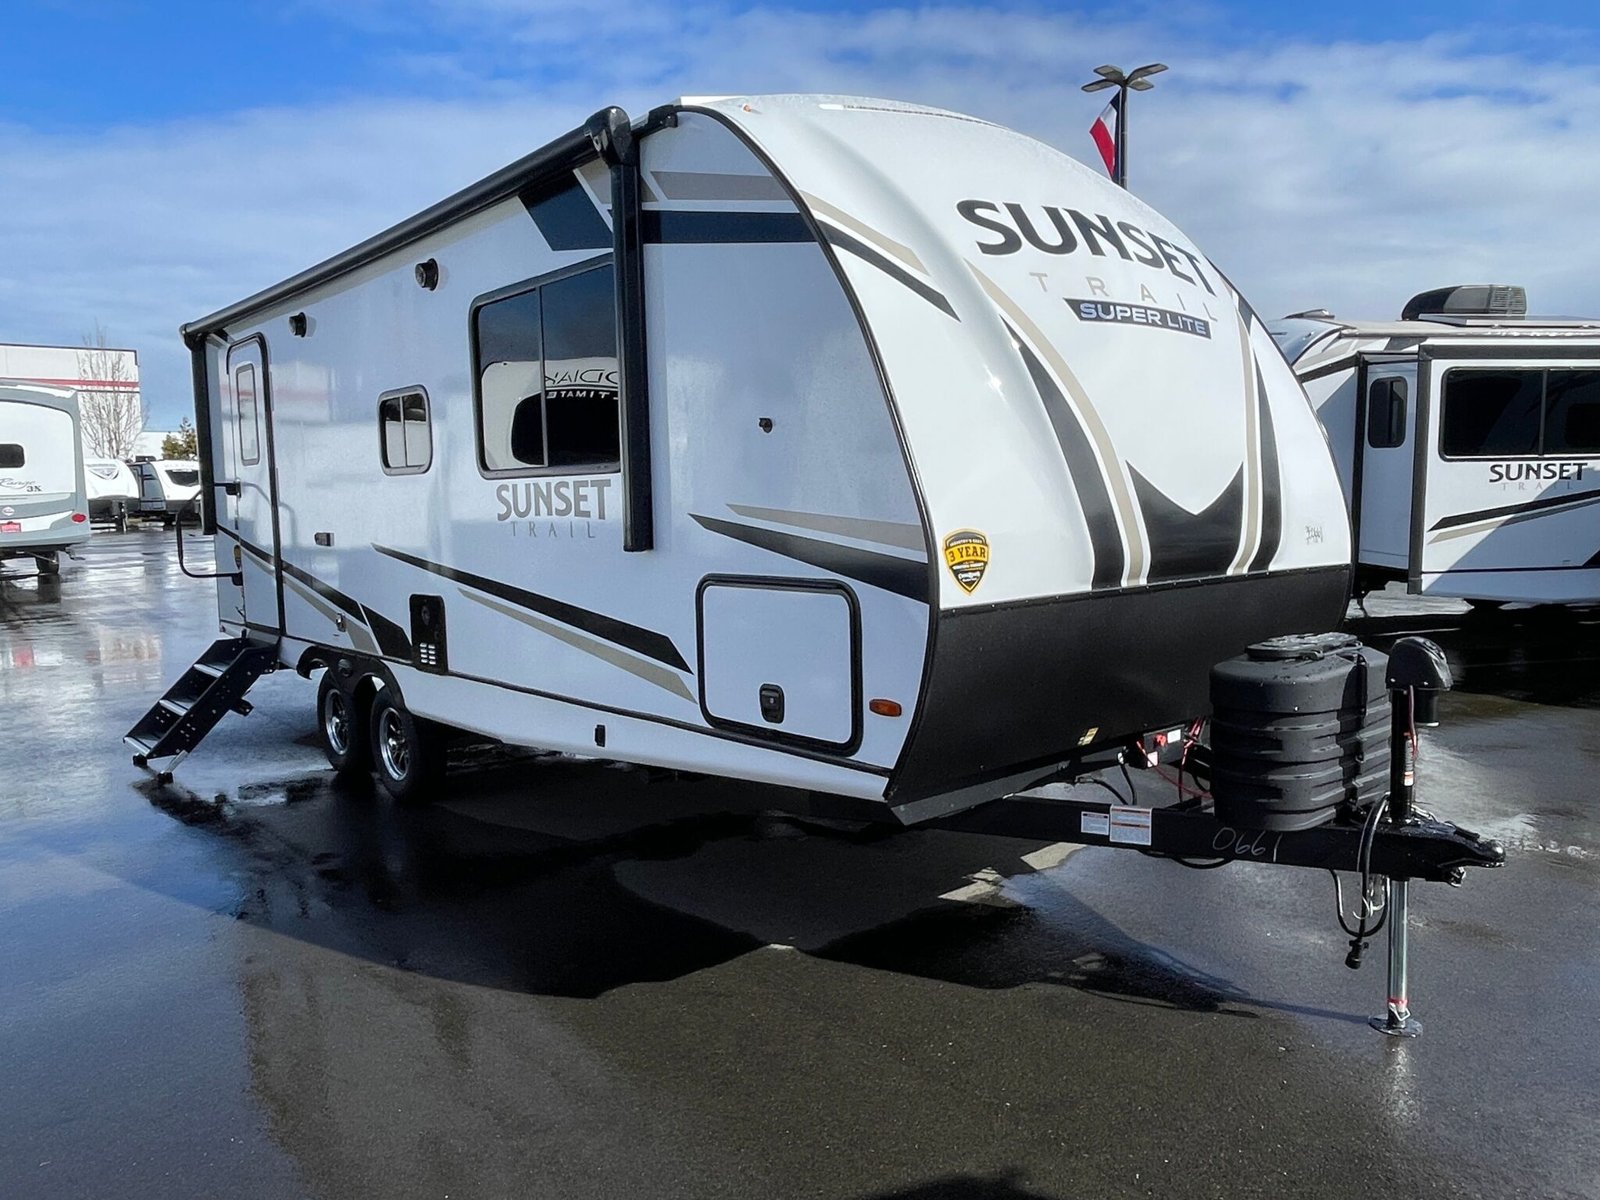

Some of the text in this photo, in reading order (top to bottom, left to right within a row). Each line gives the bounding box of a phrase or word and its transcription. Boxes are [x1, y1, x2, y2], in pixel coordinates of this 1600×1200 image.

[956, 200, 1217, 297] SUNSET
[1030, 272, 1217, 322] TRAIL
[1079, 303, 1206, 335] SUPER LITE
[1489, 463, 1588, 482] SUNSET
[1501, 482, 1573, 491] TRAIL
[496, 479, 611, 521] SUNSET
[510, 521, 596, 539] TRAIL
[949, 546, 986, 562] 3 YEAR
